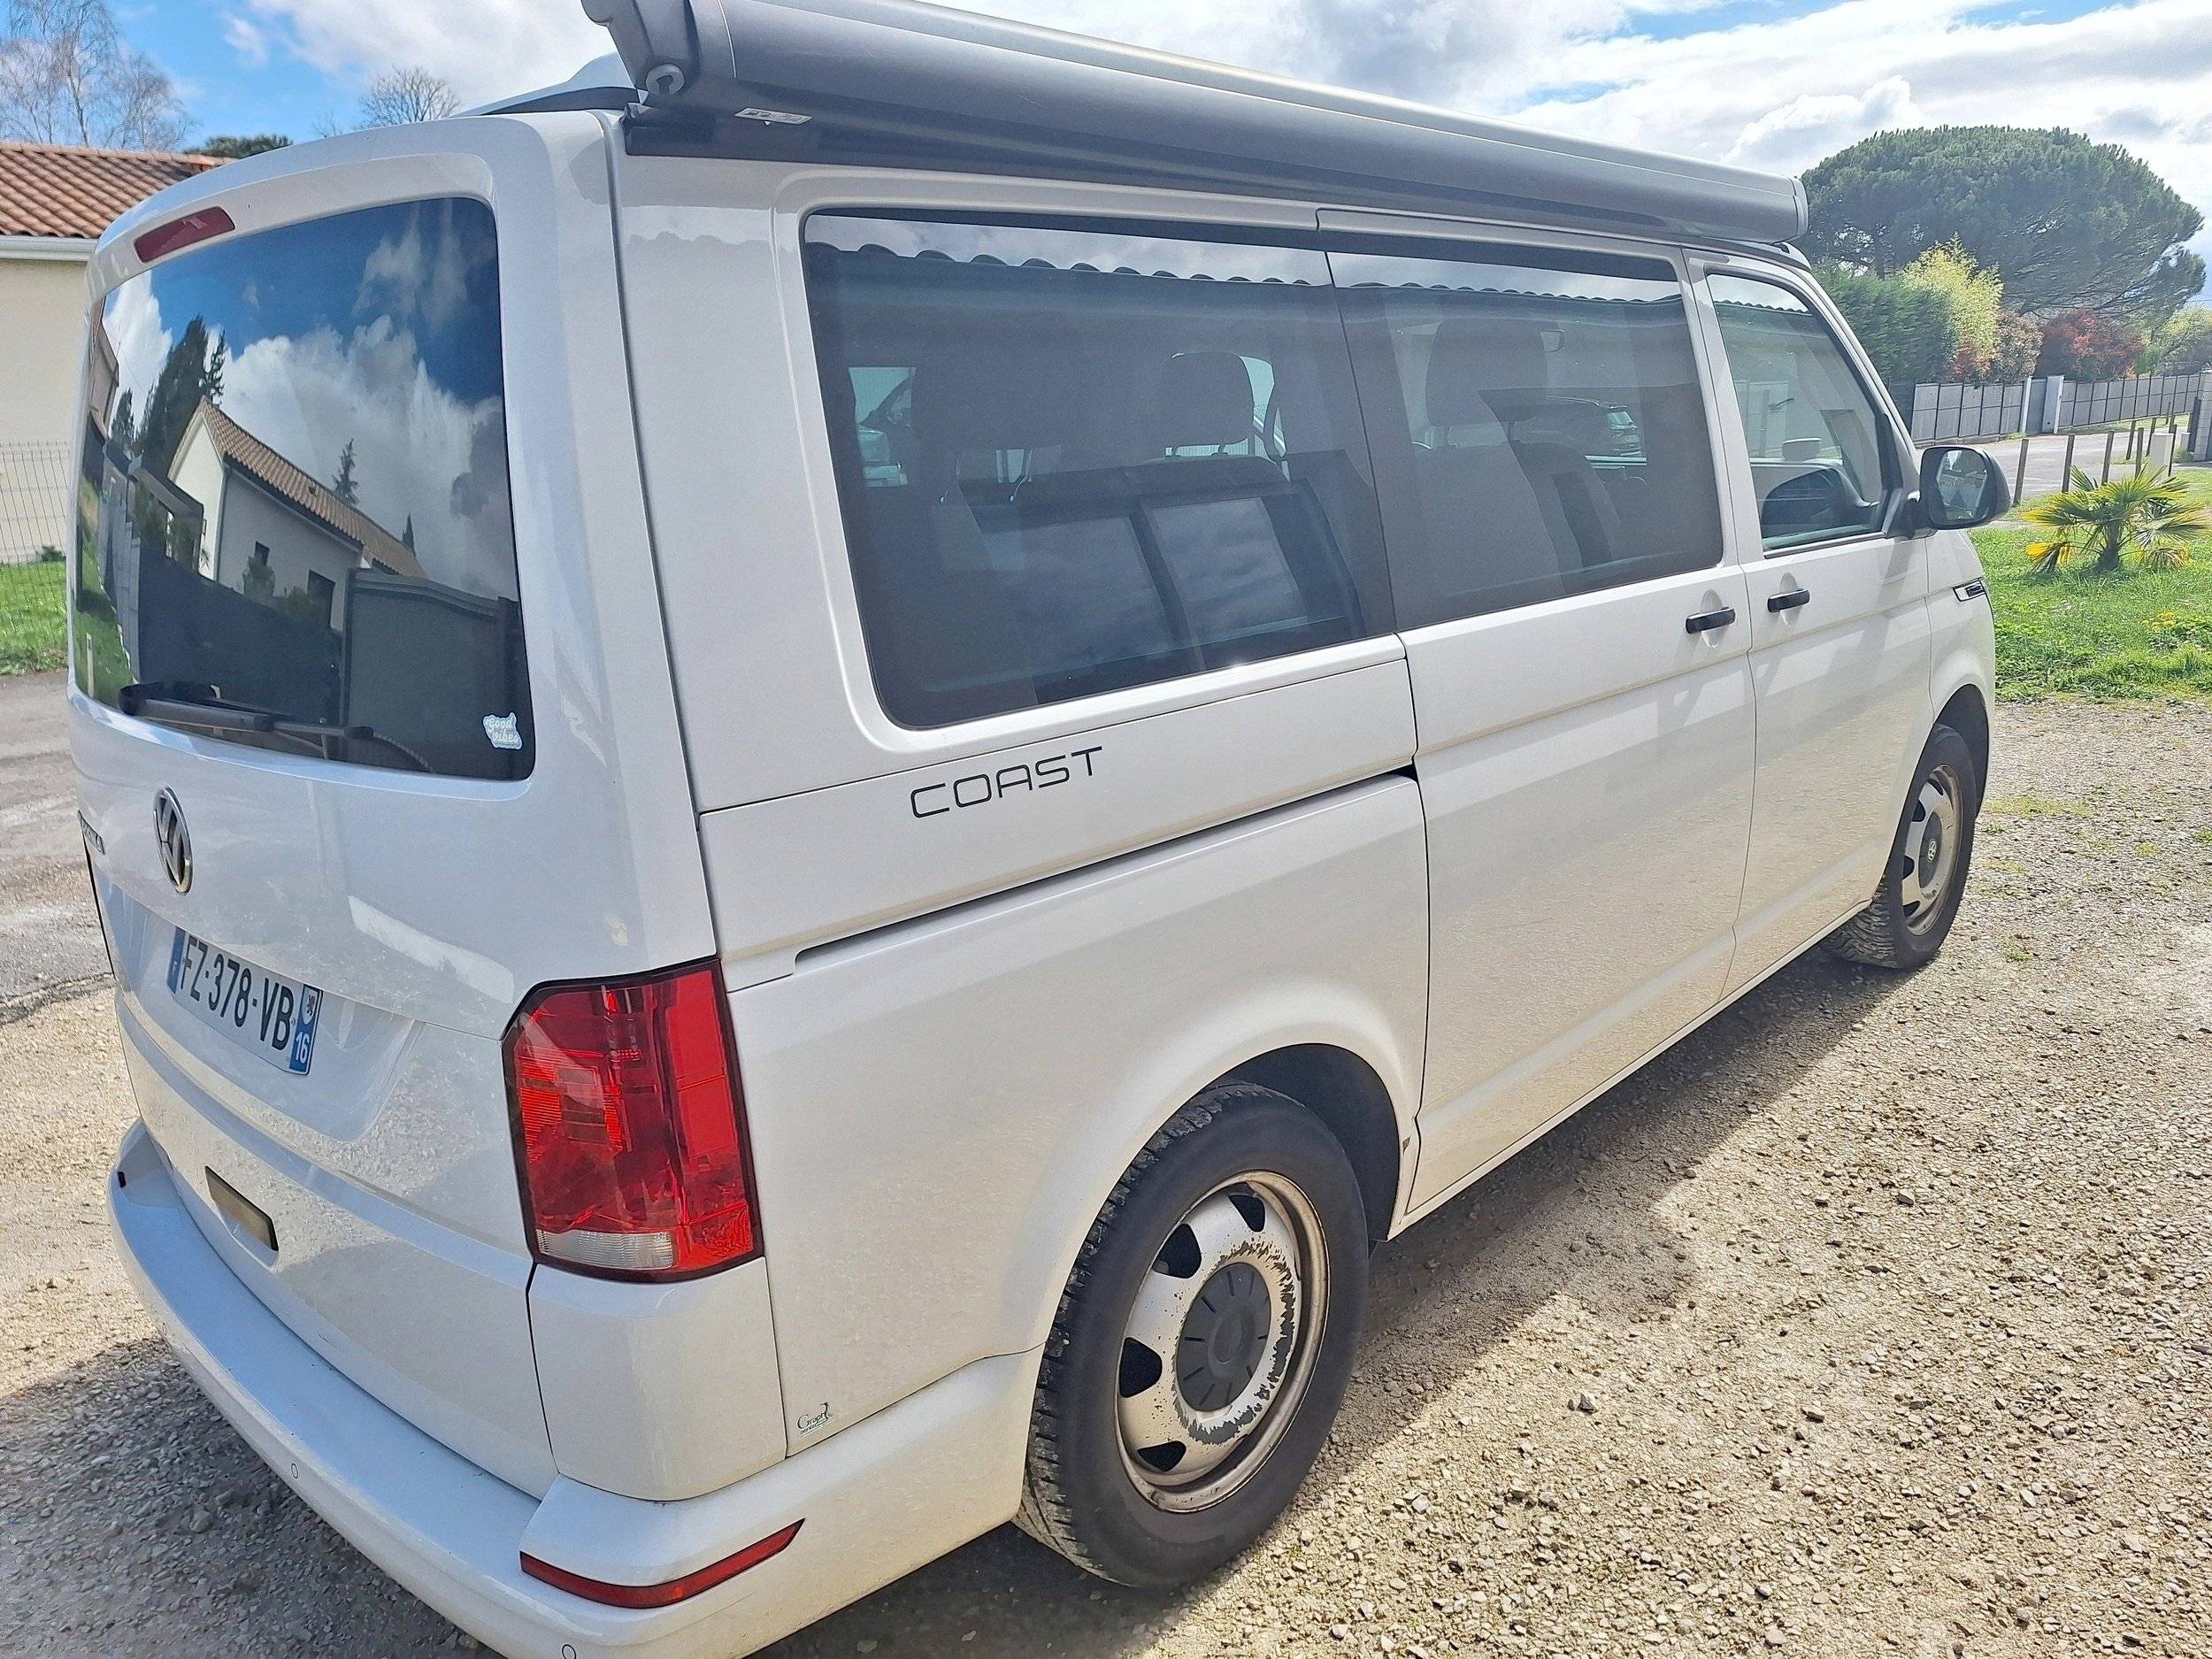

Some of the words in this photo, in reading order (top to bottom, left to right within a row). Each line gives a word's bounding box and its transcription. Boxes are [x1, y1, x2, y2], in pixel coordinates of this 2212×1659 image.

[910, 746, 1102, 818] COAST
[180, 934, 294, 1051] FZ-378-VB
[295, 1032, 310, 1064] 16
